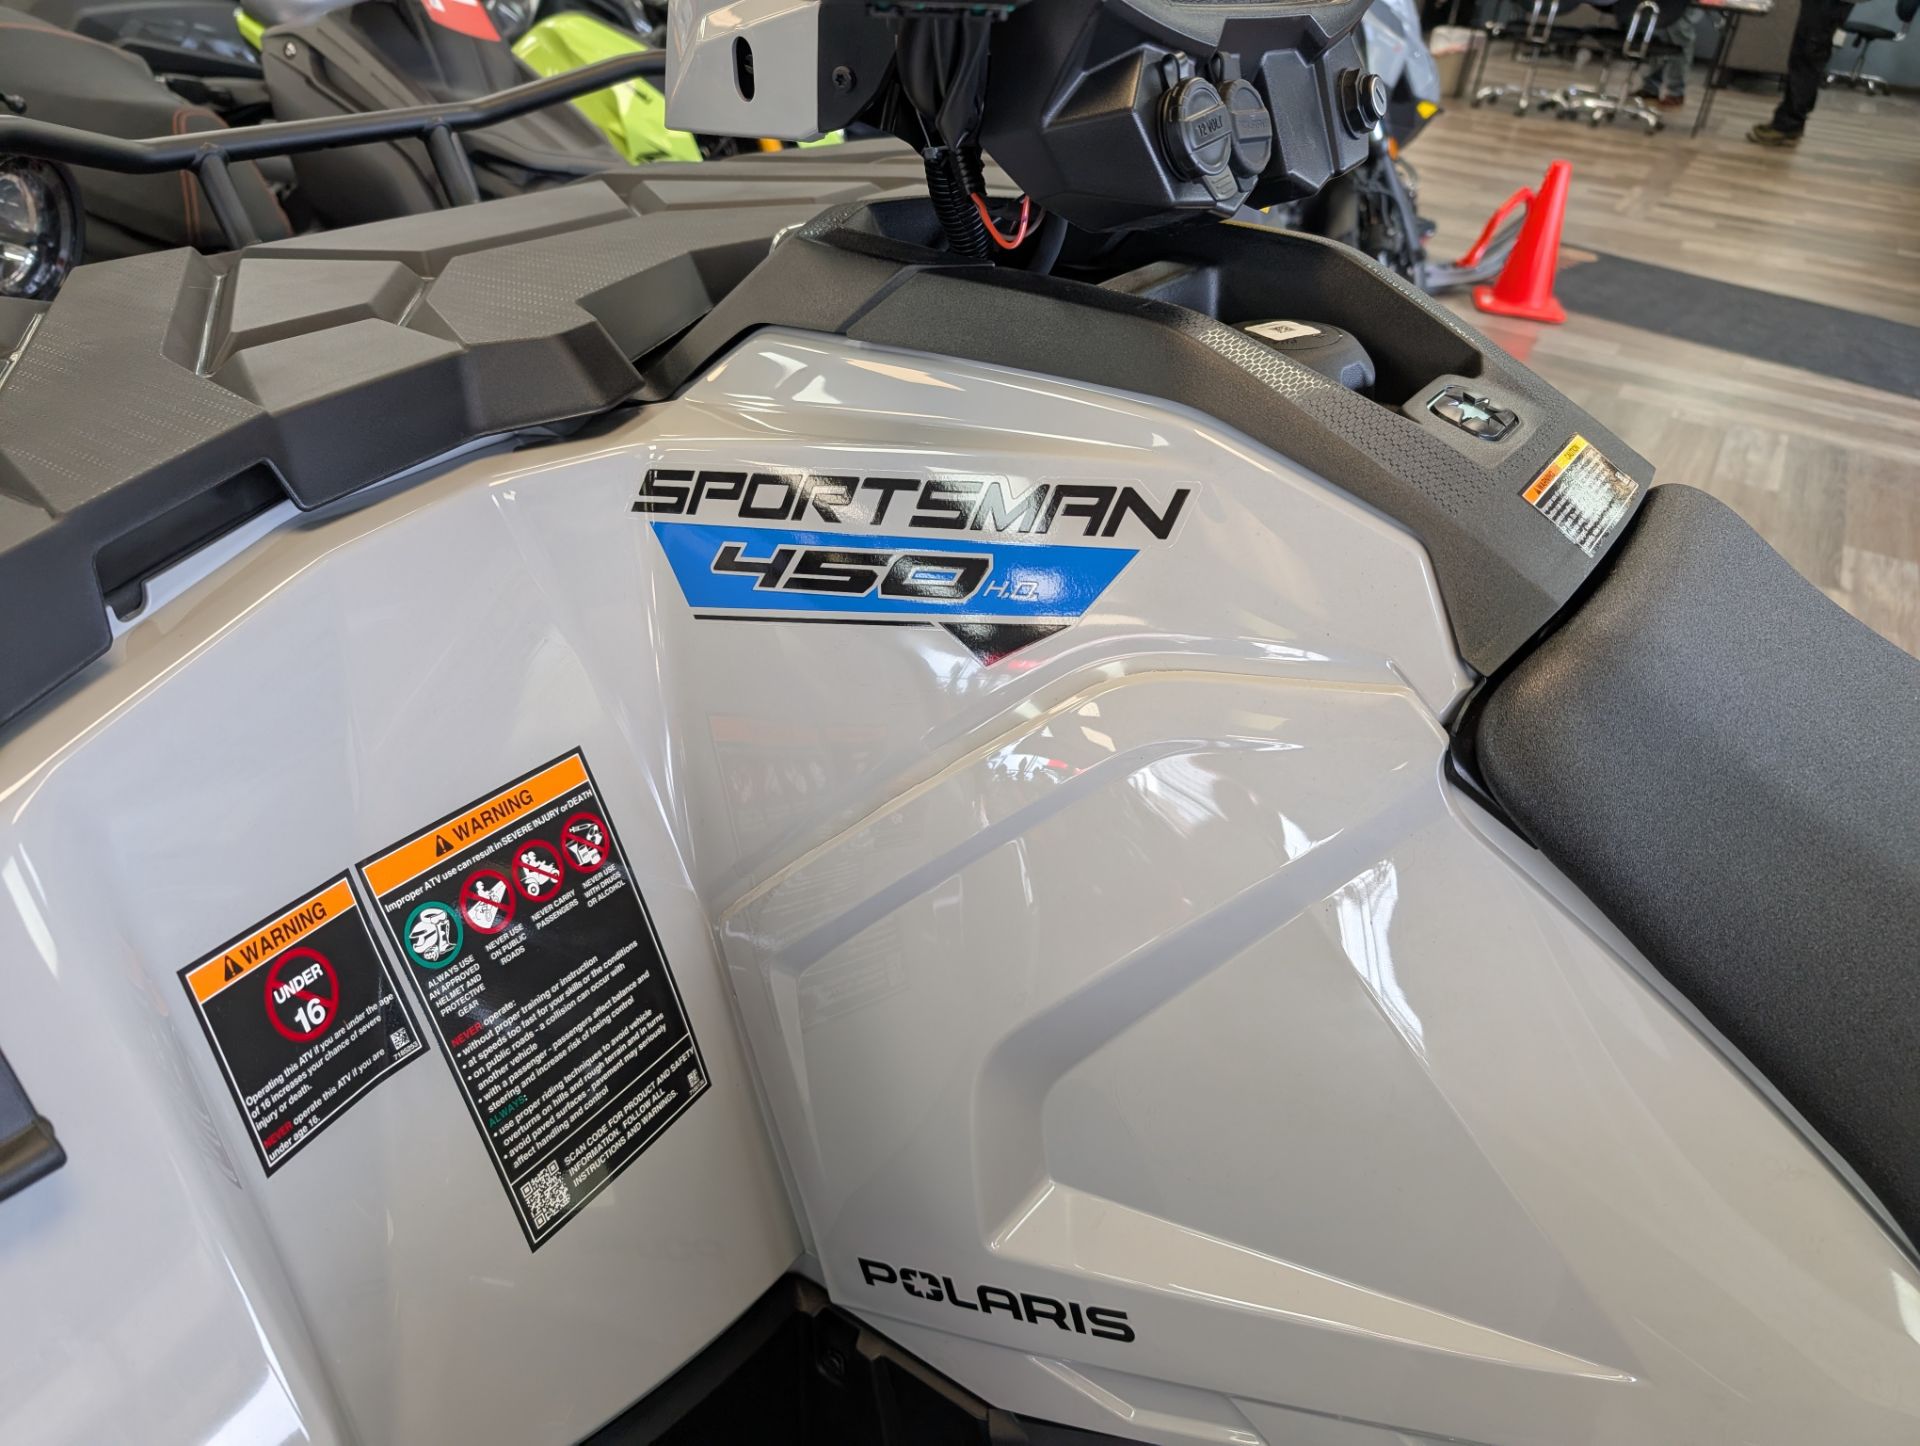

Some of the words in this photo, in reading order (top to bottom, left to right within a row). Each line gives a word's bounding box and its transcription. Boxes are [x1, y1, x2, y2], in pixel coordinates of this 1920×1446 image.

[1198, 123, 1207, 136] 12
[631, 469, 1191, 539] SPORTSMAN
[712, 543, 990, 600] 450
[452, 789, 534, 841] WARNING
[384, 886, 423, 913] Improper
[424, 874, 441, 891] ATV
[441, 867, 457, 880] use
[456, 858, 473, 871] can
[471, 844, 495, 863] result
[493, 841, 503, 850] in
[500, 822, 534, 846] SEVERE
[531, 806, 559, 828] INJURY
[560, 803, 568, 812] or
[566, 788, 593, 808] DEATH
[582, 871, 603, 889] NEVER
[602, 863, 616, 875] USE
[583, 884, 601, 898] WITH
[599, 870, 621, 888] DRUGS
[587, 897, 598, 907] OR
[597, 879, 626, 901] ALCOHOL
[531, 903, 554, 921] NEVER
[553, 889, 575, 907] CARRY
[536, 898, 579, 930] PASSENGERS
[239, 901, 327, 964] WARNING
[485, 932, 509, 951] NEVER
[508, 922, 524, 936] USE
[490, 948, 502, 960] ON
[501, 932, 527, 953] PUBLIC
[500, 945, 525, 965] ROADS
[273, 963, 323, 1004] UNDER
[428, 964, 459, 989] ALWAYS
[458, 954, 475, 968] USE
[429, 988, 441, 1000] AN
[441, 963, 480, 993] APPROVED
[435, 983, 465, 1008] HELMET
[466, 973, 482, 988] AND
[294, 997, 326, 1033] 16
[439, 983, 485, 1017] PROTECTIVE
[451, 1022, 482, 1045] NEVER
[483, 999, 516, 1026] operate:
[457, 999, 479, 1017] GEAR
[461, 1029, 494, 1055] without
[493, 1010, 520, 1036] proper
[520, 989, 552, 1014] training
[550, 982, 559, 993] or
[559, 955, 598, 987] instruction
[467, 1055, 478, 1067] at
[477, 1035, 508, 1060] speeds
[506, 1025, 522, 1039] too
[520, 1012, 537, 1029] fast
[536, 1004, 548, 1017] for
[548, 992, 565, 1011] your
[564, 980, 583, 997] skills
[582, 974, 590, 984] or
[590, 965, 603, 978] the
[602, 940, 638, 969] conditions
[472, 1066, 485, 1078] on
[485, 1047, 511, 1072] public
[511, 1030, 535, 1051] roads
[538, 1022, 546, 1031] a
[545, 999, 577, 1026] collision
[576, 989, 590, 1003] can
[590, 973, 610, 992] occur
[609, 962, 625, 977] with
[245, 1073, 285, 1106] Operating
[283, 1062, 299, 1077] this
[298, 1048, 313, 1067] ATV
[312, 1044, 320, 1055] if
[319, 1035, 334, 1052] you
[333, 1027, 346, 1040] are
[345, 1011, 365, 1030] under
[365, 1003, 378, 1015] the
[378, 993, 394, 1007] age
[482, 1084, 502, 1101] with
[501, 1079, 508, 1088] a
[507, 1049, 547, 1085] passenger
[551, 1015, 593, 1051] passengers
[592, 999, 612, 1019] affect
[610, 981, 637, 1004] balance
[636, 969, 650, 984] and
[487, 1084, 521, 1113] steering
[520, 1071, 536, 1088] and
[535, 1049, 567, 1076] increase
[566, 1037, 582, 1052] risk
[581, 1029, 590, 1041] of
[588, 1014, 612, 1035] losing
[610, 995, 634, 1018] control
[250, 1105, 260, 1119] of
[260, 1097, 271, 1110] 16
[270, 1071, 308, 1103] increases
[306, 1057, 324, 1076] your
[324, 1038, 350, 1061] chance
[350, 1030, 358, 1041] of
[358, 1015, 381, 1035] severe
[477, 1063, 509, 1090] another
[509, 1042, 538, 1066] vehicle
[498, 1119, 515, 1135] use
[514, 1098, 541, 1124] proper
[541, 1080, 565, 1102] riding
[563, 1049, 603, 1083] techniques
[601, 1043, 611, 1052] to
[610, 1025, 630, 1046] avoid
[628, 1009, 652, 1030] vehicle
[503, 1113, 541, 1146] overturns
[541, 1104, 553, 1116] on
[551, 1090, 570, 1107] hills
[569, 1077, 584, 1094] and
[583, 1061, 605, 1082] rough
[604, 1043, 627, 1065] terrain
[626, 1030, 640, 1046] and
[639, 1026, 647, 1036] in
[646, 1012, 664, 1029] turns
[508, 1133, 532, 1157] avoid
[531, 1114, 556, 1141] paved
[555, 1090, 587, 1119] surfaces
[590, 1058, 624, 1092] pavement
[623, 1047, 638, 1063] may
[637, 1023, 666, 1051] seriously
[254, 1108, 278, 1131] injury
[278, 1101, 287, 1112] or
[288, 1084, 312, 1105] death.
[262, 1120, 293, 1149] NEVER
[292, 1098, 323, 1125] operate
[321, 1086, 337, 1101] this
[337, 1071, 351, 1090] ATV
[351, 1067, 358, 1077] if
[357, 1057, 372, 1074] you
[371, 1048, 385, 1061] are
[489, 1093, 528, 1128] ALWAYS:
[563, 1142, 587, 1166] SCAN
[586, 1123, 608, 1146] CODE
[607, 1110, 624, 1128] FOR
[623, 1080, 655, 1114] PRODUCT
[656, 1068, 670, 1085] AND
[670, 1045, 694, 1072] SAFETY
[268, 1137, 292, 1161] under
[293, 1125, 310, 1143] age
[308, 1114, 320, 1127] 16.
[513, 1145, 536, 1169] affect
[535, 1119, 570, 1150] handling
[569, 1105, 584, 1123] and
[583, 1084, 609, 1110] control
[568, 1128, 621, 1177] INFORMATION.
[622, 1098, 651, 1129] FOLLOW
[652, 1088, 665, 1103] ALL
[572, 1135, 626, 1187] INSTRUCTIONS
[626, 1121, 641, 1140] AND
[640, 1089, 680, 1125] WARNINGS.
[857, 1257, 1135, 1343] POLARIS
